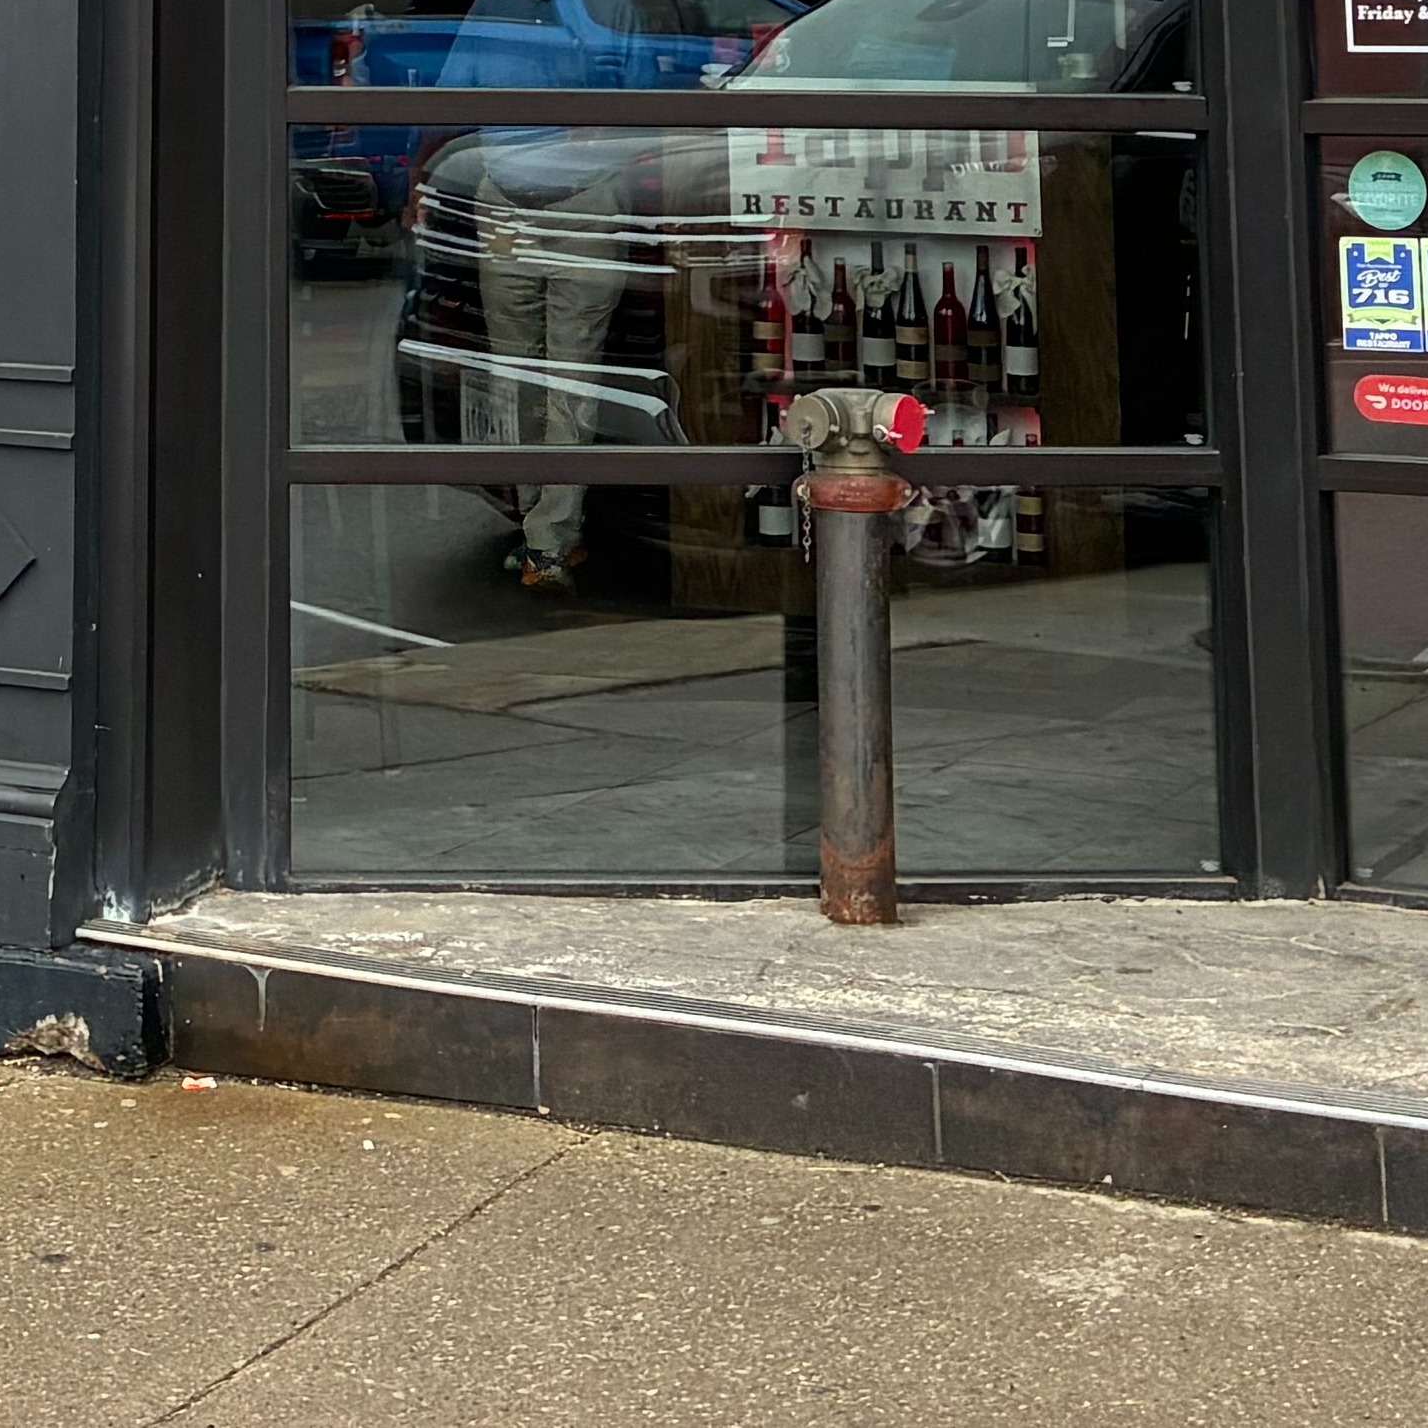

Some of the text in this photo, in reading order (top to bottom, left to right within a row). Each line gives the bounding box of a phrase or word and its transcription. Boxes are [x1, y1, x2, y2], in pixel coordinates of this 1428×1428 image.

[1357, 5, 1414, 24] Friday
[742, 194, 1028, 223] RESTAURANT
[1357, 270, 1401, 287] Best
[1352, 288, 1410, 304] 716
[1378, 384, 1395, 393] We
